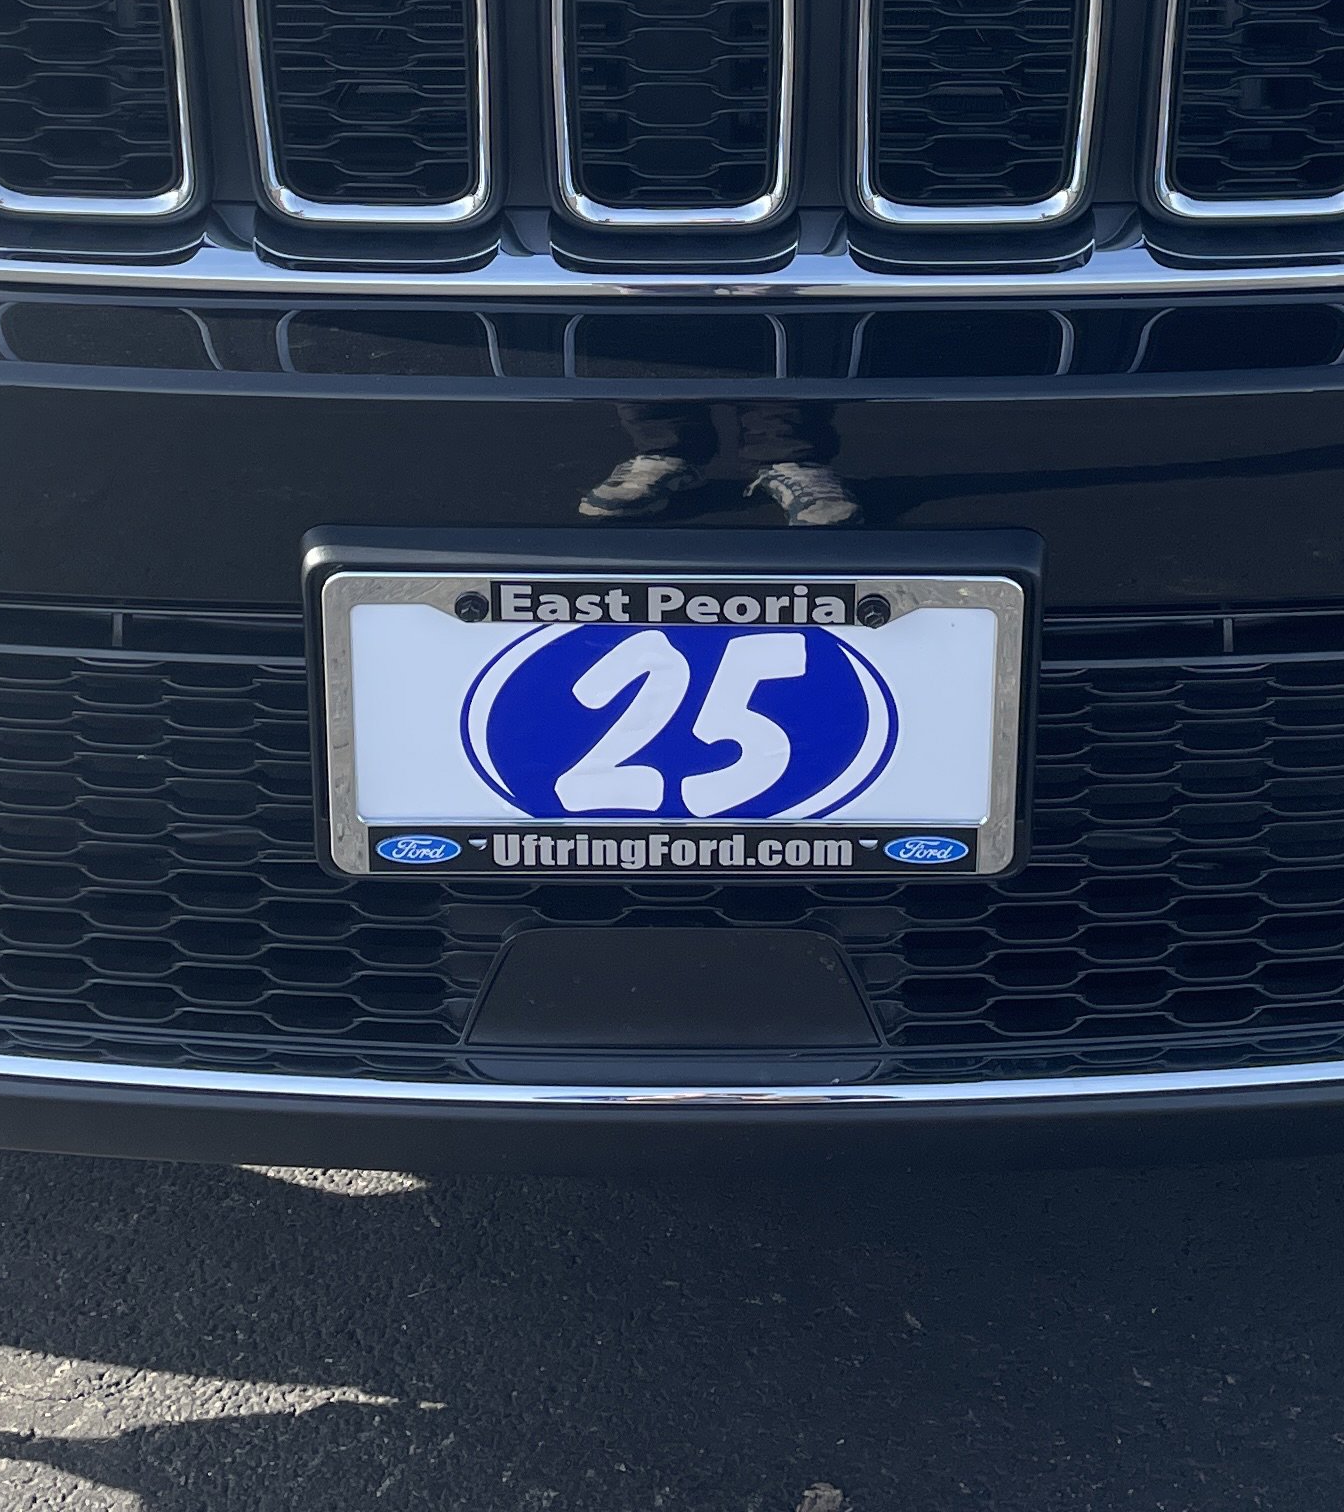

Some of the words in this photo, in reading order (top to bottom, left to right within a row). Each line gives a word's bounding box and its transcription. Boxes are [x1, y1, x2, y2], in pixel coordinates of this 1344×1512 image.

[500, 584, 631, 622] East
[647, 585, 846, 625] Peoria
[554, 629, 807, 818] 25
[391, 839, 445, 860] Ford
[492, 833, 853, 870] UftringFord.com
[898, 839, 953, 860] Ford
